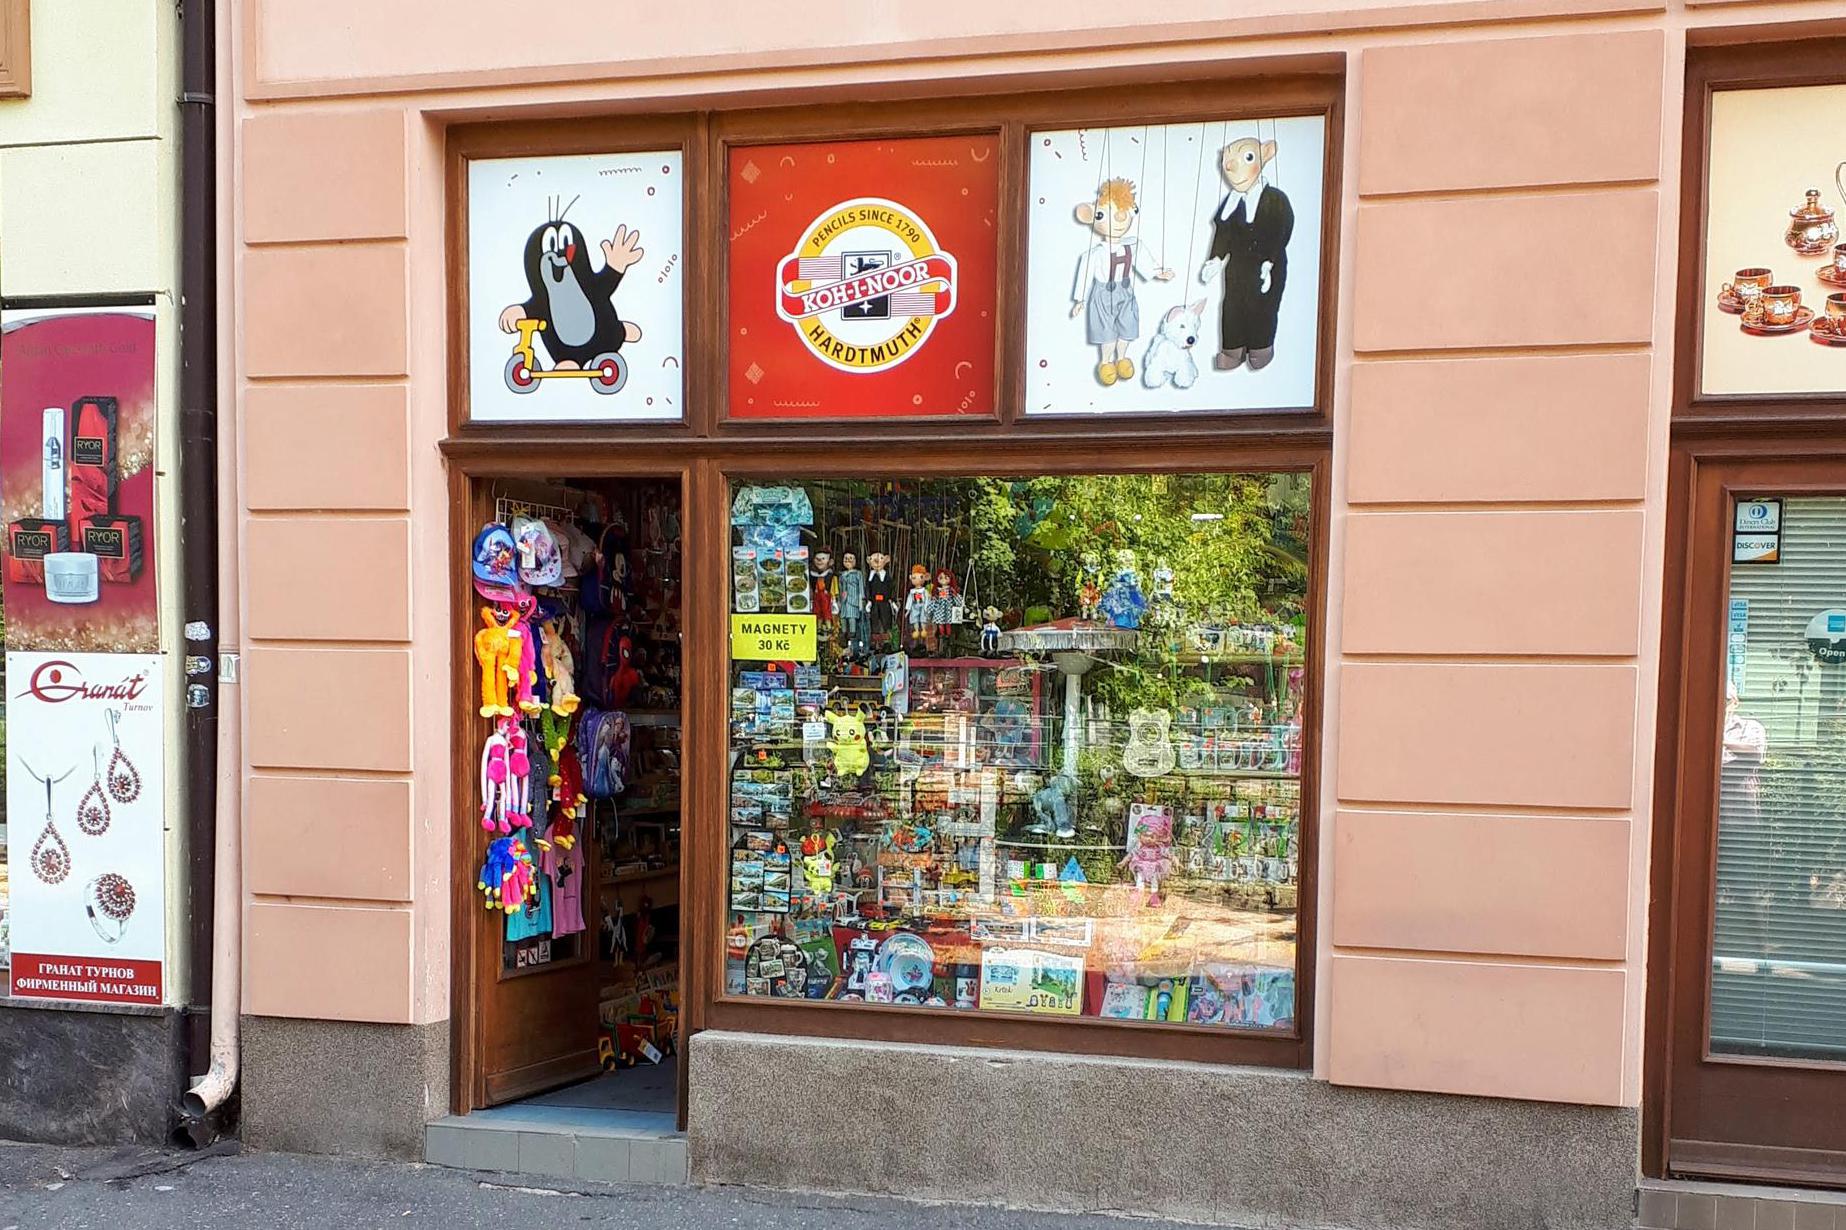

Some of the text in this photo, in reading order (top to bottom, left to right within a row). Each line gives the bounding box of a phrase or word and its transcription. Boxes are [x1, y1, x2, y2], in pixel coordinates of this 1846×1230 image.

[812, 209, 920, 248] PENCILS SINCE 1790
[800, 262, 930, 314] KOH-I-NOOR
[809, 327, 922, 363] HARDTMUTH
[77, 440, 102, 450] RYOR
[18, 535, 48, 546] RYOR
[88, 532, 120, 544] RYOR
[1736, 542, 1776, 550] DISCOVER
[742, 624, 807, 634] MAGNETY
[758, 640, 790, 650] 30 Kč
[1818, 647, 1845, 658] Open
[124, 703, 154, 712] Turnov
[39, 963, 134, 978] ГРАНАТ ТУРНОВ
[16, 977, 156, 996] ФИРМЕННЫЙ МАГАЗИН
